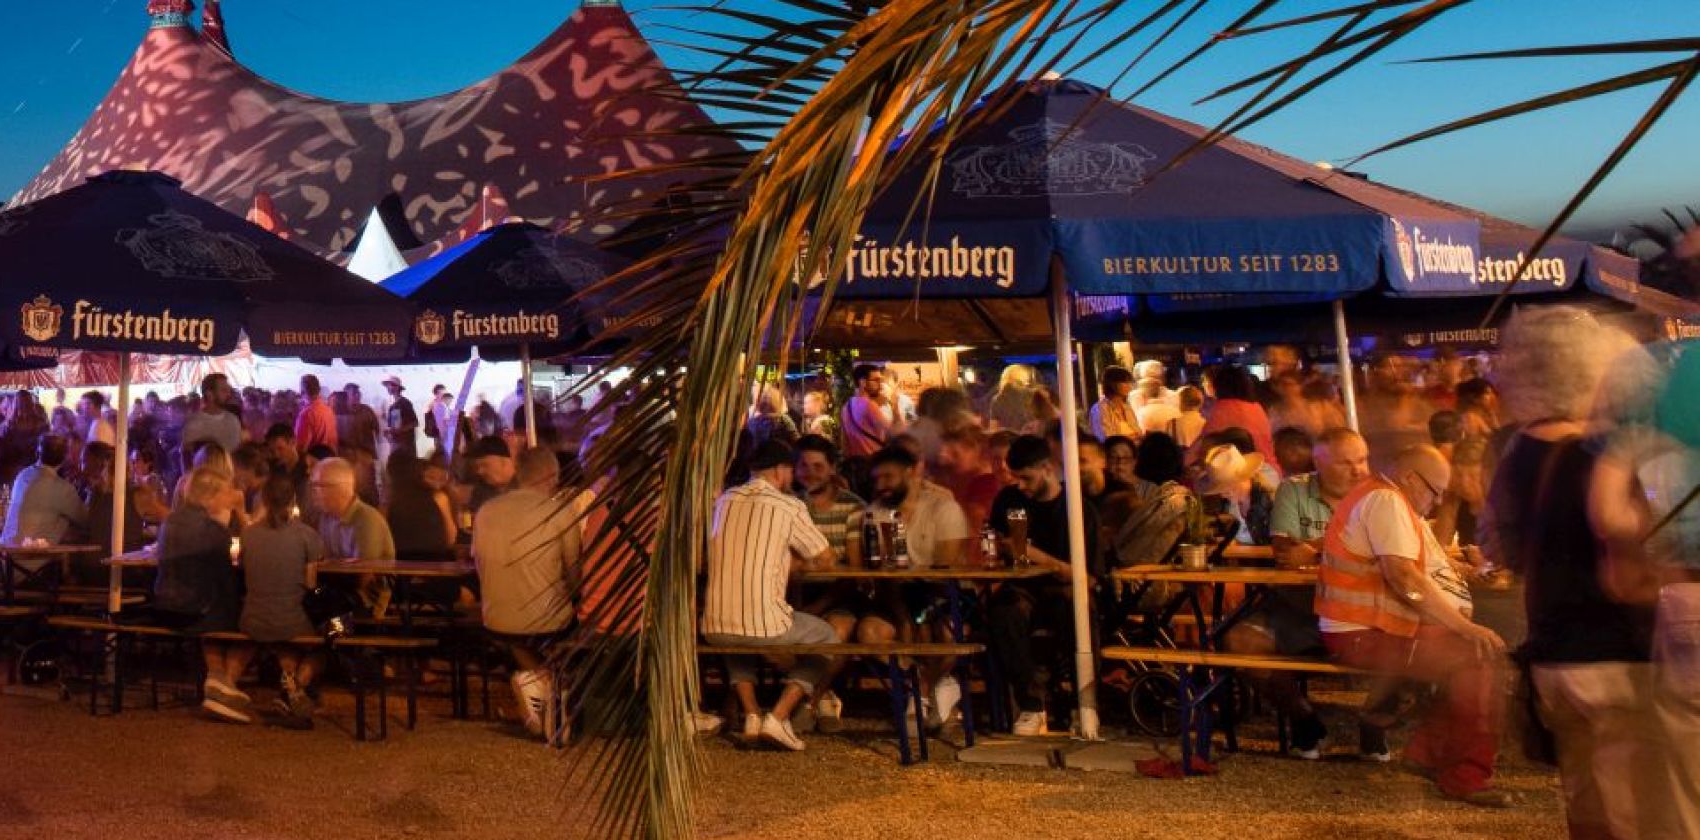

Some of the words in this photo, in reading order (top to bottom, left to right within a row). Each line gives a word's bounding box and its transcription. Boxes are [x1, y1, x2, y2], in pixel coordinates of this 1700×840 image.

[845, 233, 1014, 288] Fürstenberg
[1103, 256, 1232, 274] BIERKULTUR
[1239, 254, 1282, 272] SEIT
[1289, 253, 1339, 272] 1283
[1478, 250, 1566, 287] stenberg
[72, 298, 215, 352] Fürstenberg
[274, 330, 341, 346] BIERKULTUR
[343, 331, 366, 346] SEIT
[369, 331, 396, 345] 1283
[452, 308, 559, 341] Fürstenberg
